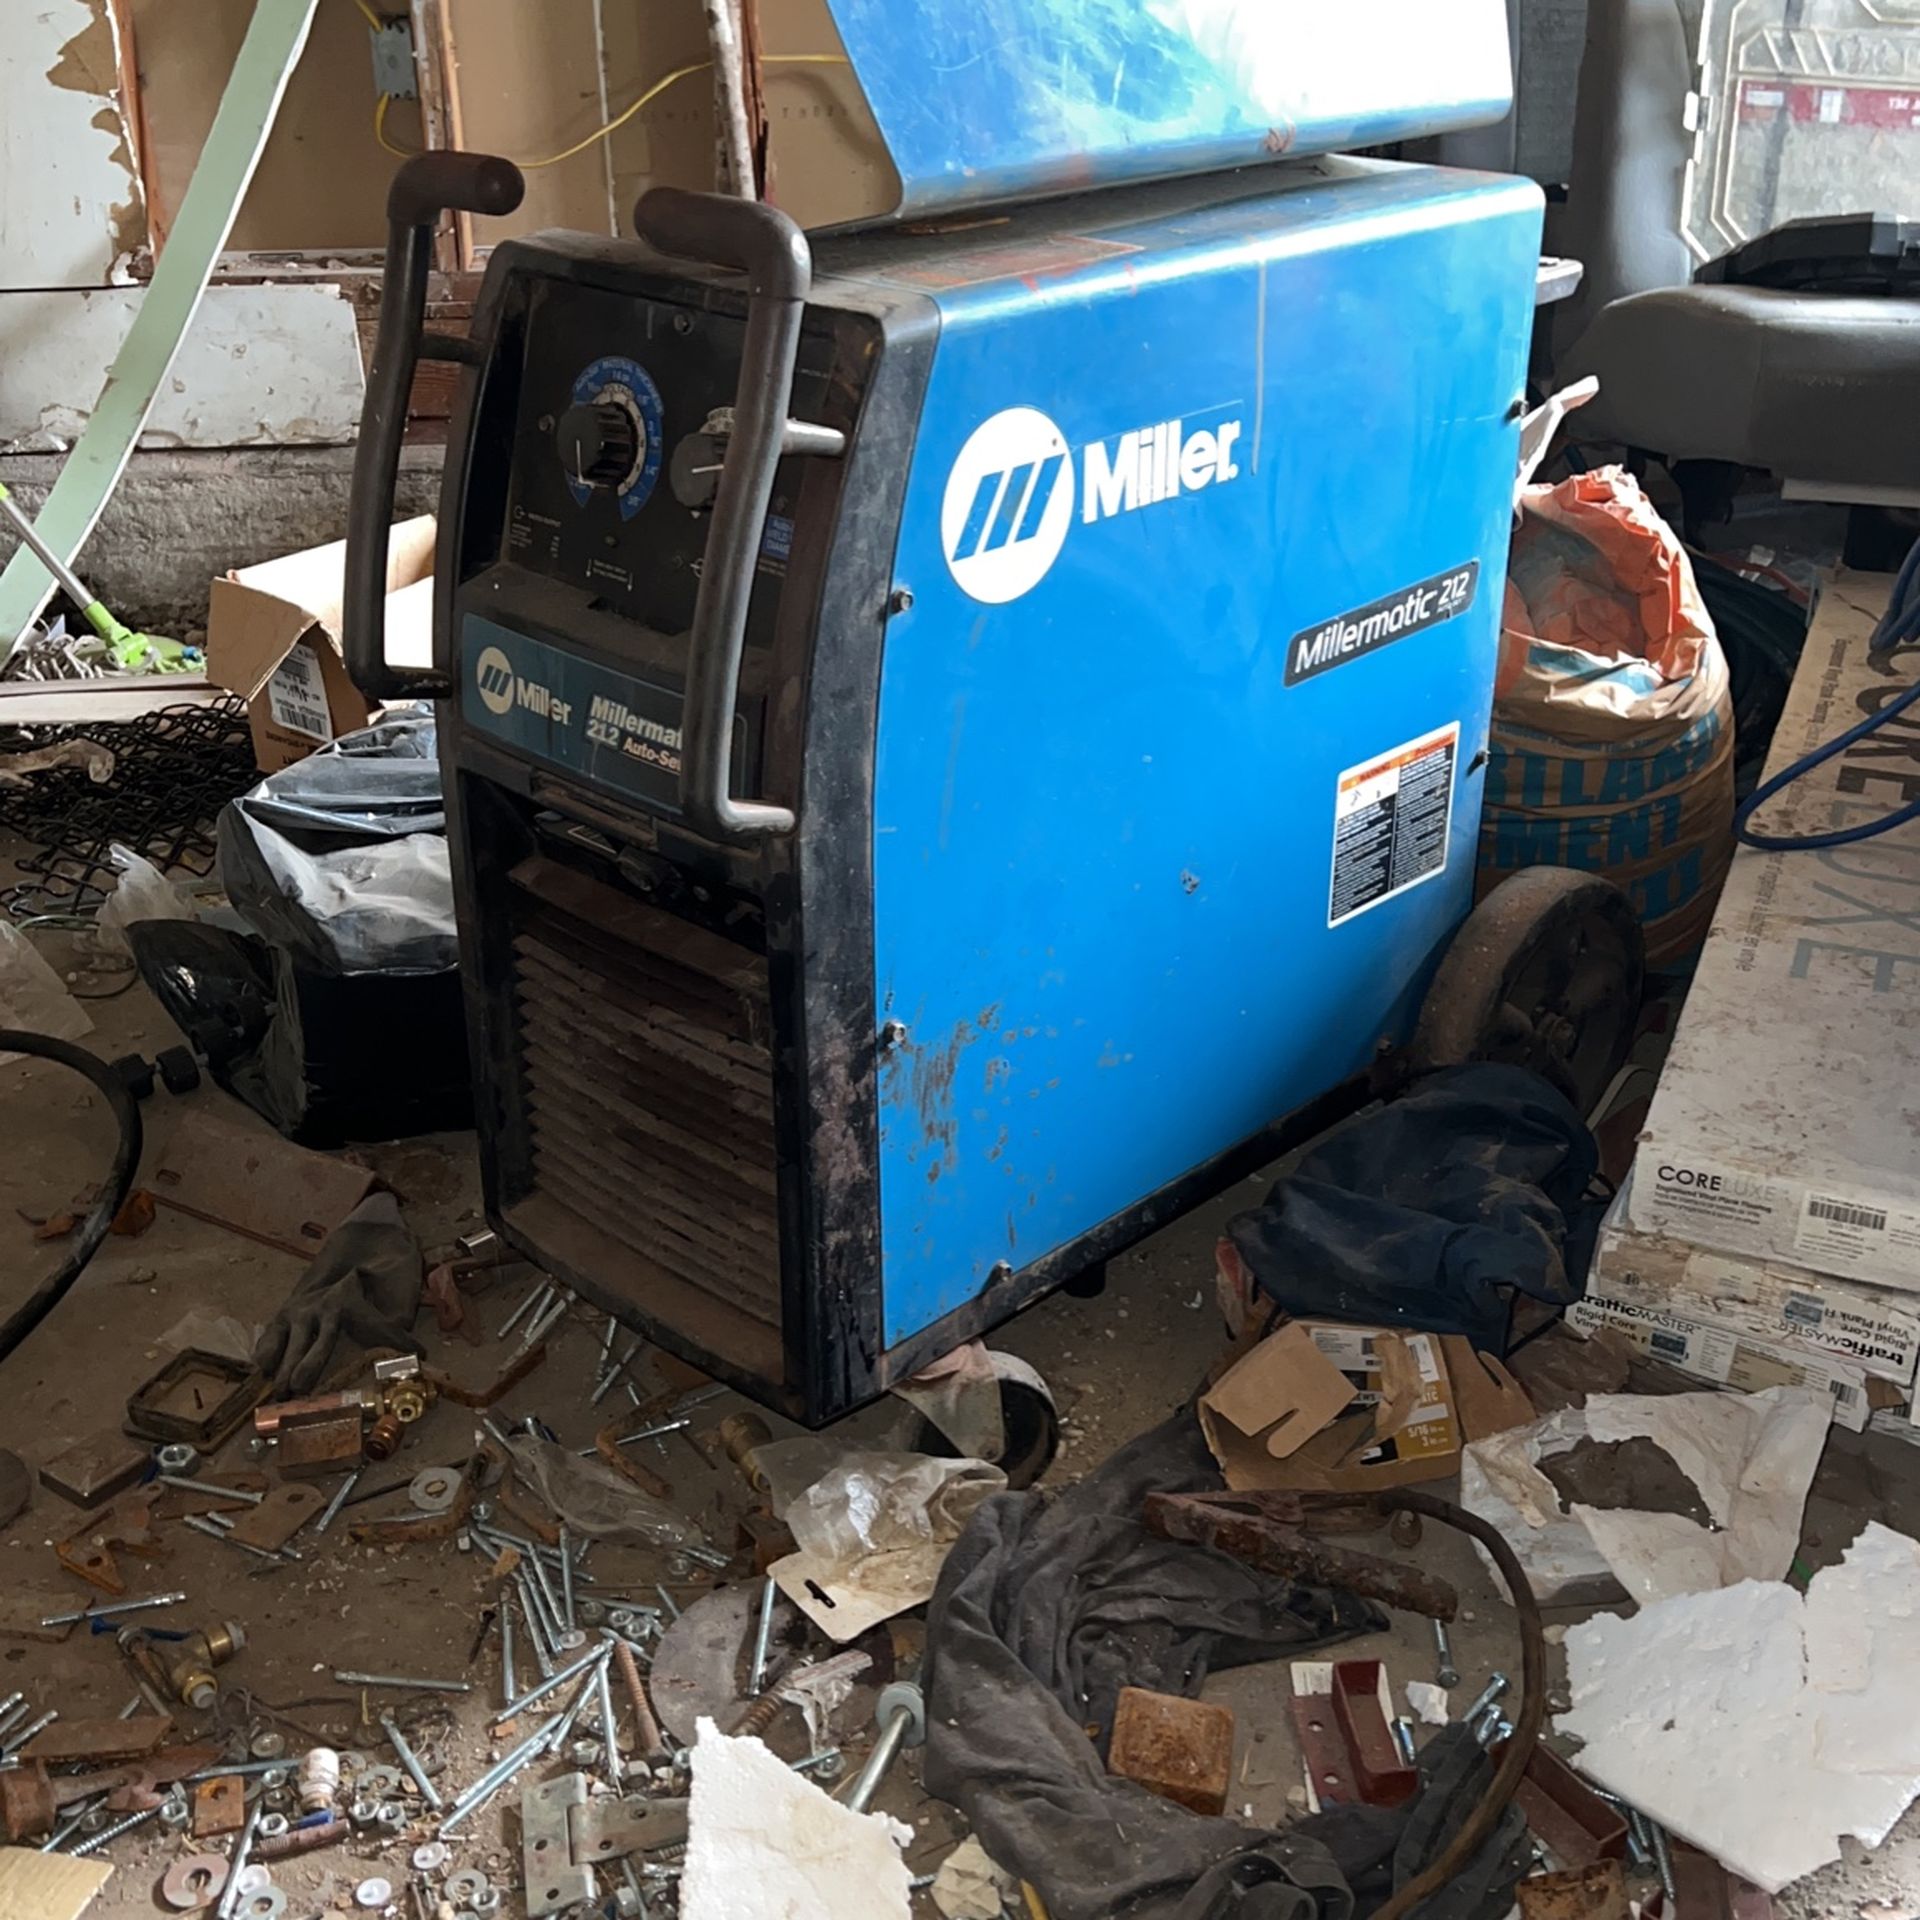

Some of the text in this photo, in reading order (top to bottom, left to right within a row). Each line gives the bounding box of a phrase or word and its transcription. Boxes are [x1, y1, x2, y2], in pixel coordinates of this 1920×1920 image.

[1083, 418, 1241, 524] Miller
[1294, 571, 1470, 674] Millermatic 212
[516, 677, 572, 726] Miller
[587, 719, 620, 747] 212
[1575, 1315, 1604, 1331] Viny
[1576, 1306, 1637, 1330] Rigid Core
[1841, 1311, 1875, 1329] Plank
[1878, 1322, 1910, 1341] Vinyl
[1841, 1323, 1908, 1351] Rigid Core
